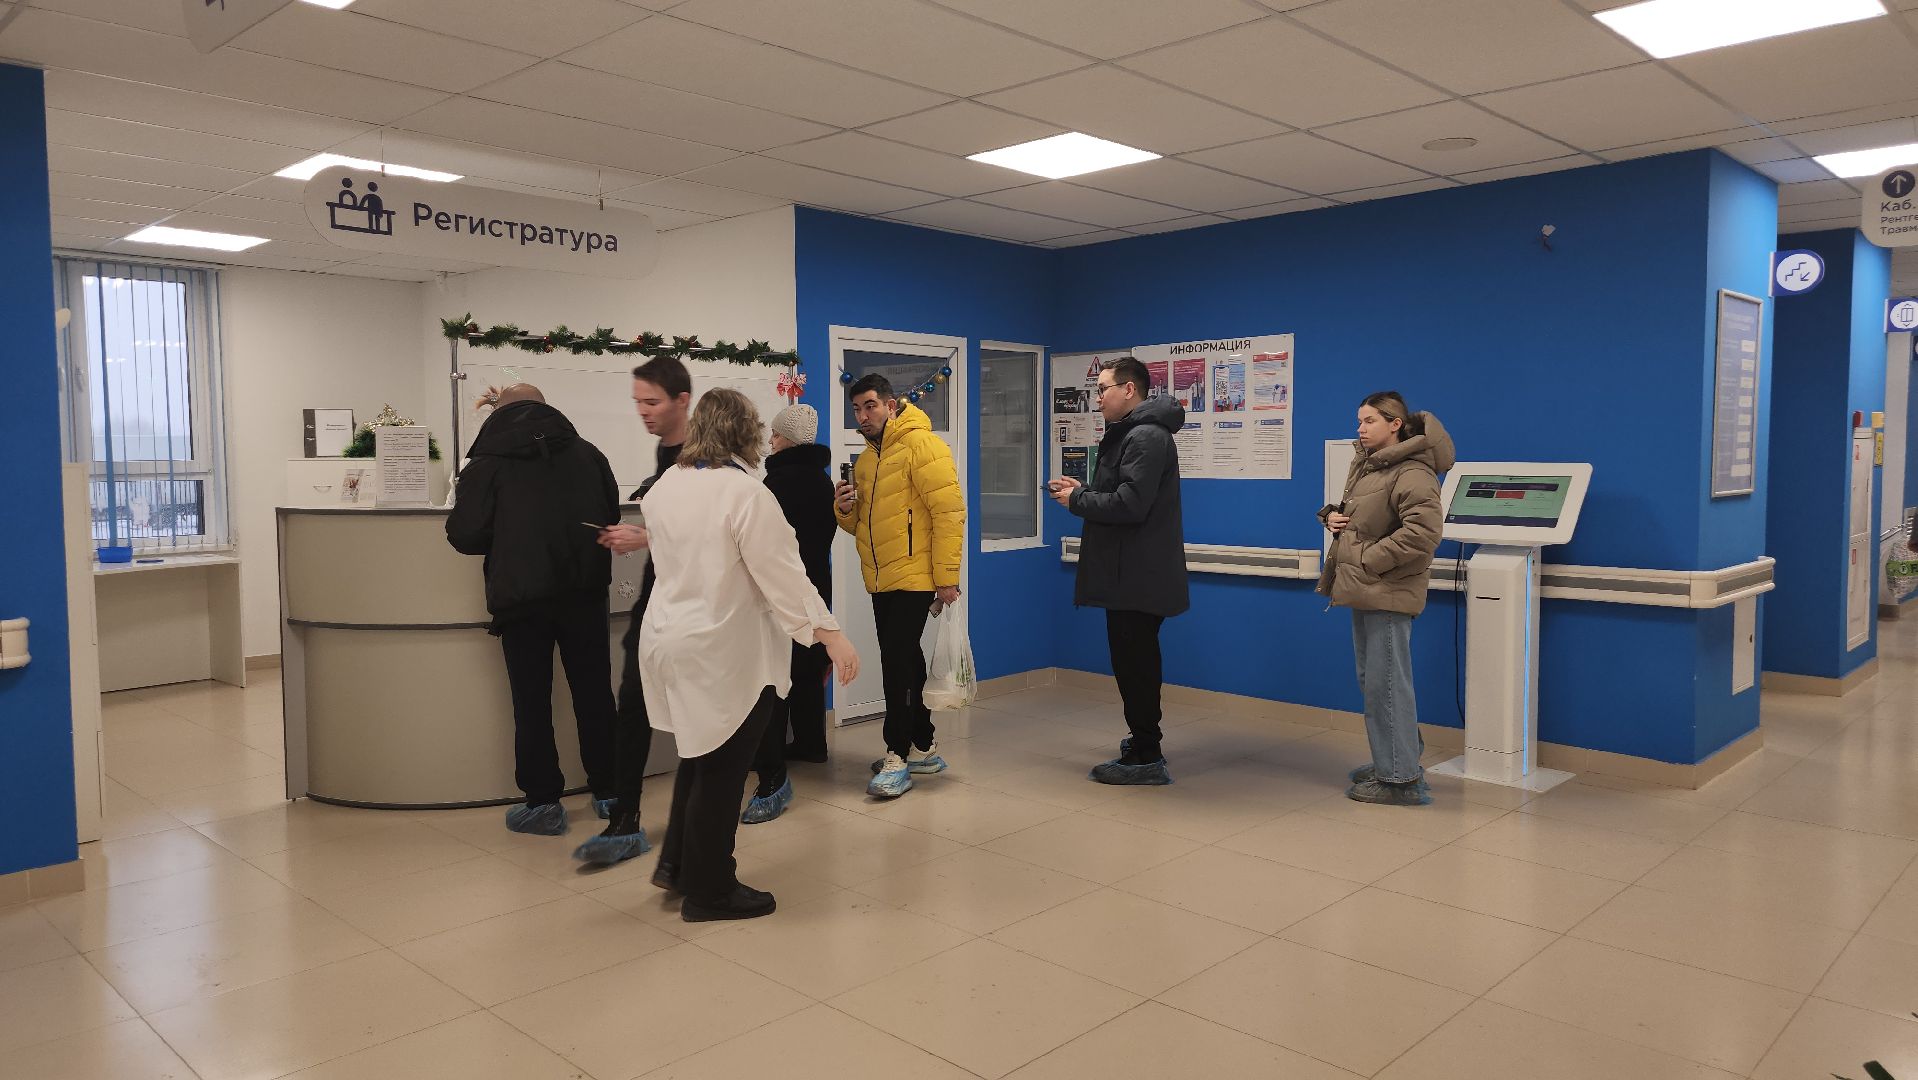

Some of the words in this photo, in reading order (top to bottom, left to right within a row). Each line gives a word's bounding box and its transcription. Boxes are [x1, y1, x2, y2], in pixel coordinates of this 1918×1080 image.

[1881, 199, 1916, 212] Каб.
[413, 202, 618, 253] Регистратура
[1880, 225, 1918, 236] Травм
[1170, 340, 1251, 355] ИНФОРМАЦИЯ
